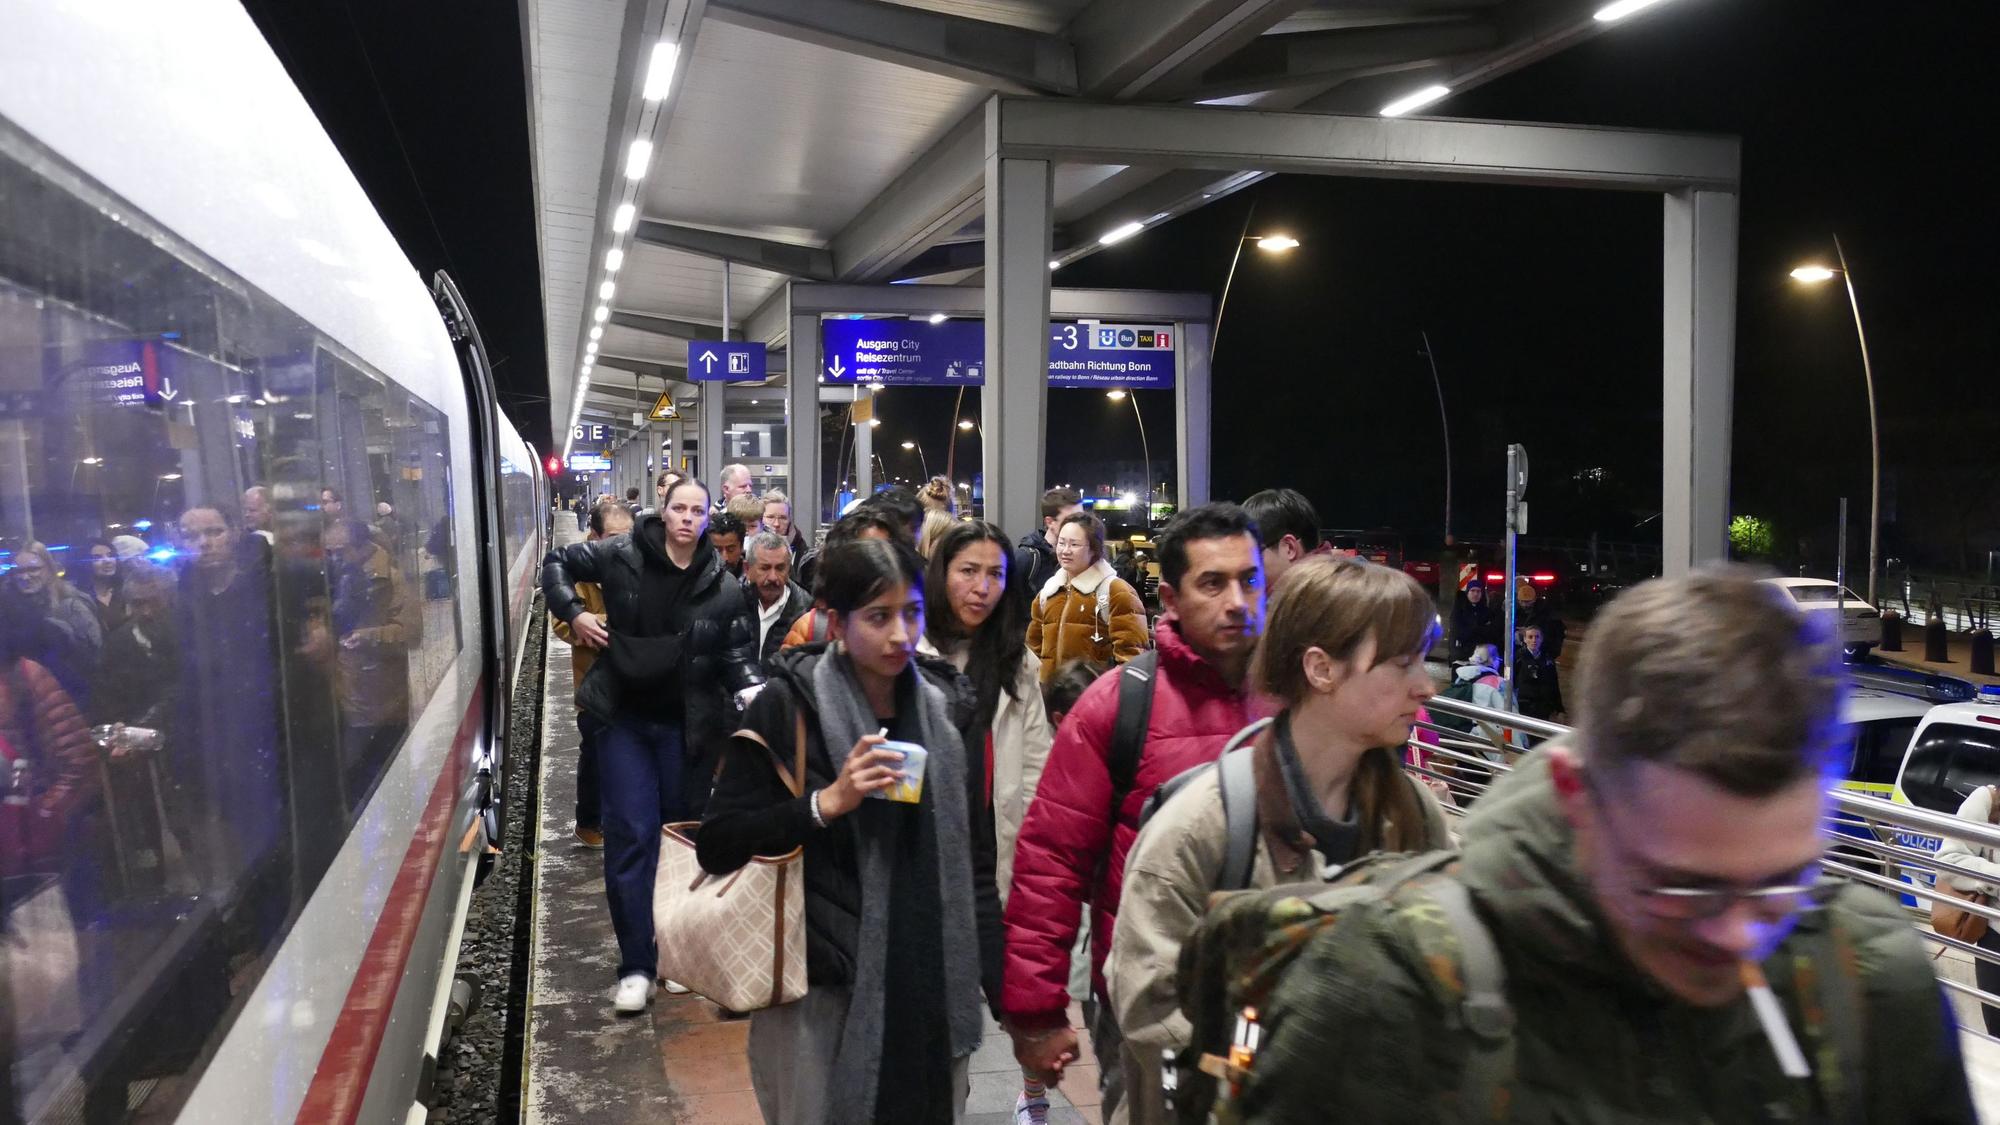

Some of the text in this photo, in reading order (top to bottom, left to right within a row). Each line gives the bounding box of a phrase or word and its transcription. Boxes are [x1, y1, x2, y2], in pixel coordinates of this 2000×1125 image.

[1053, 325, 1078, 350] -3
[856, 339, 920, 350] Ausgang City
[856, 352, 921, 363] Reisezentrum
[1048, 361, 1151, 373] adtbahn Richtung Bonn
[573, 425, 603, 439] 6 E
